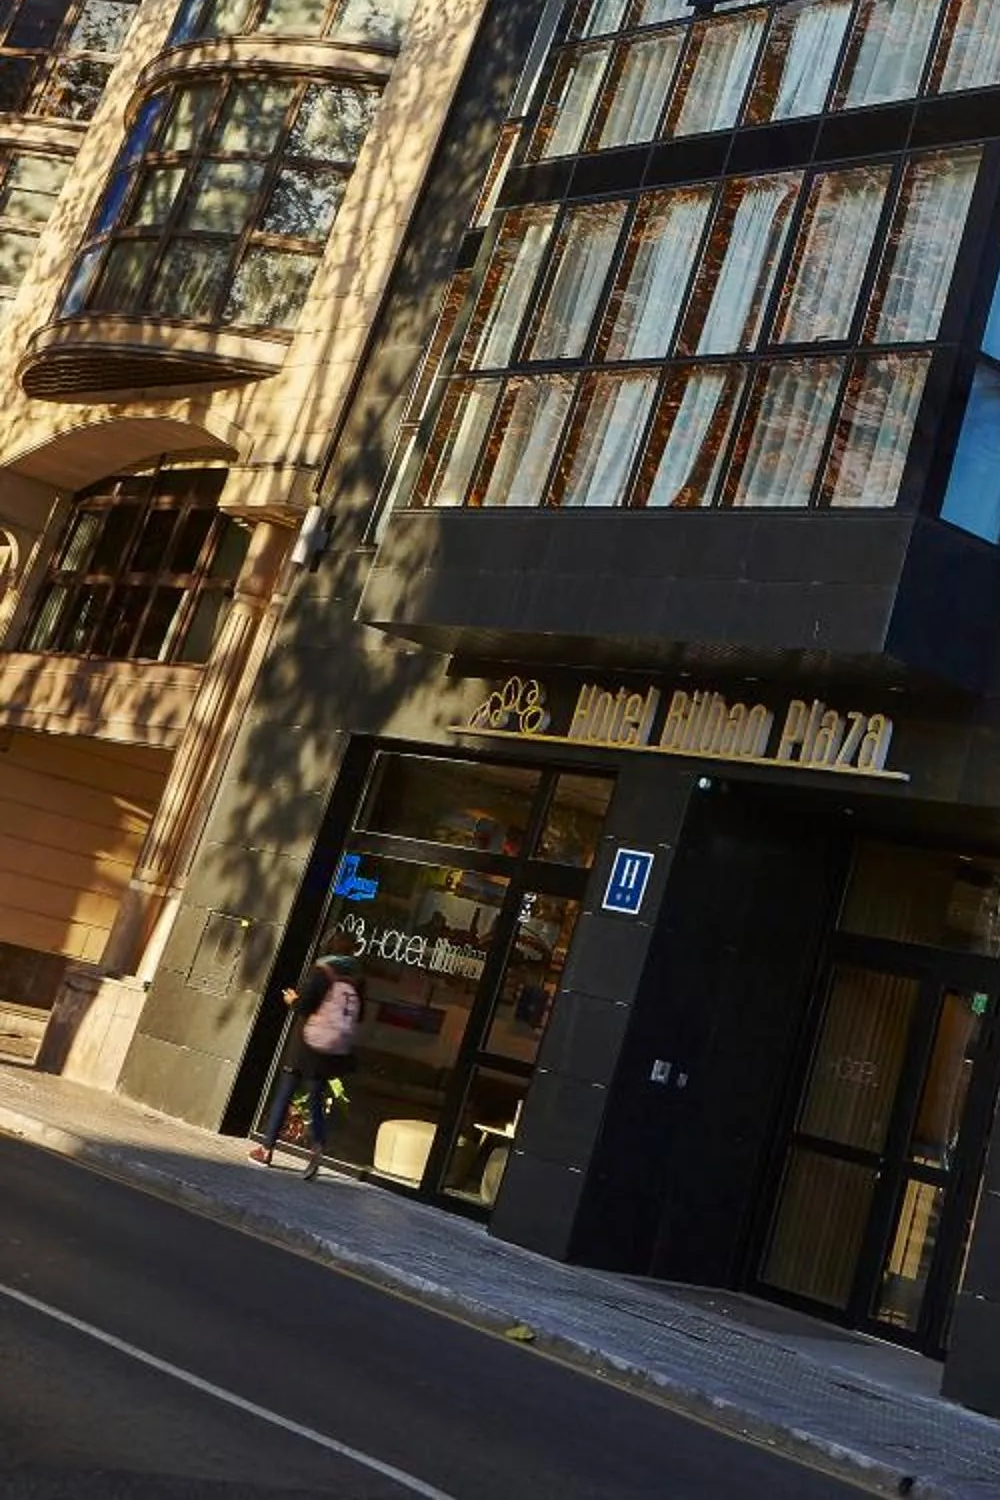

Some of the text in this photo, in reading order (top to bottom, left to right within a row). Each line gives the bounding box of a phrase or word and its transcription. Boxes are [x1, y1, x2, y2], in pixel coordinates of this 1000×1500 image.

[568, 683, 893, 771] Hotel Bilbao Plaza
